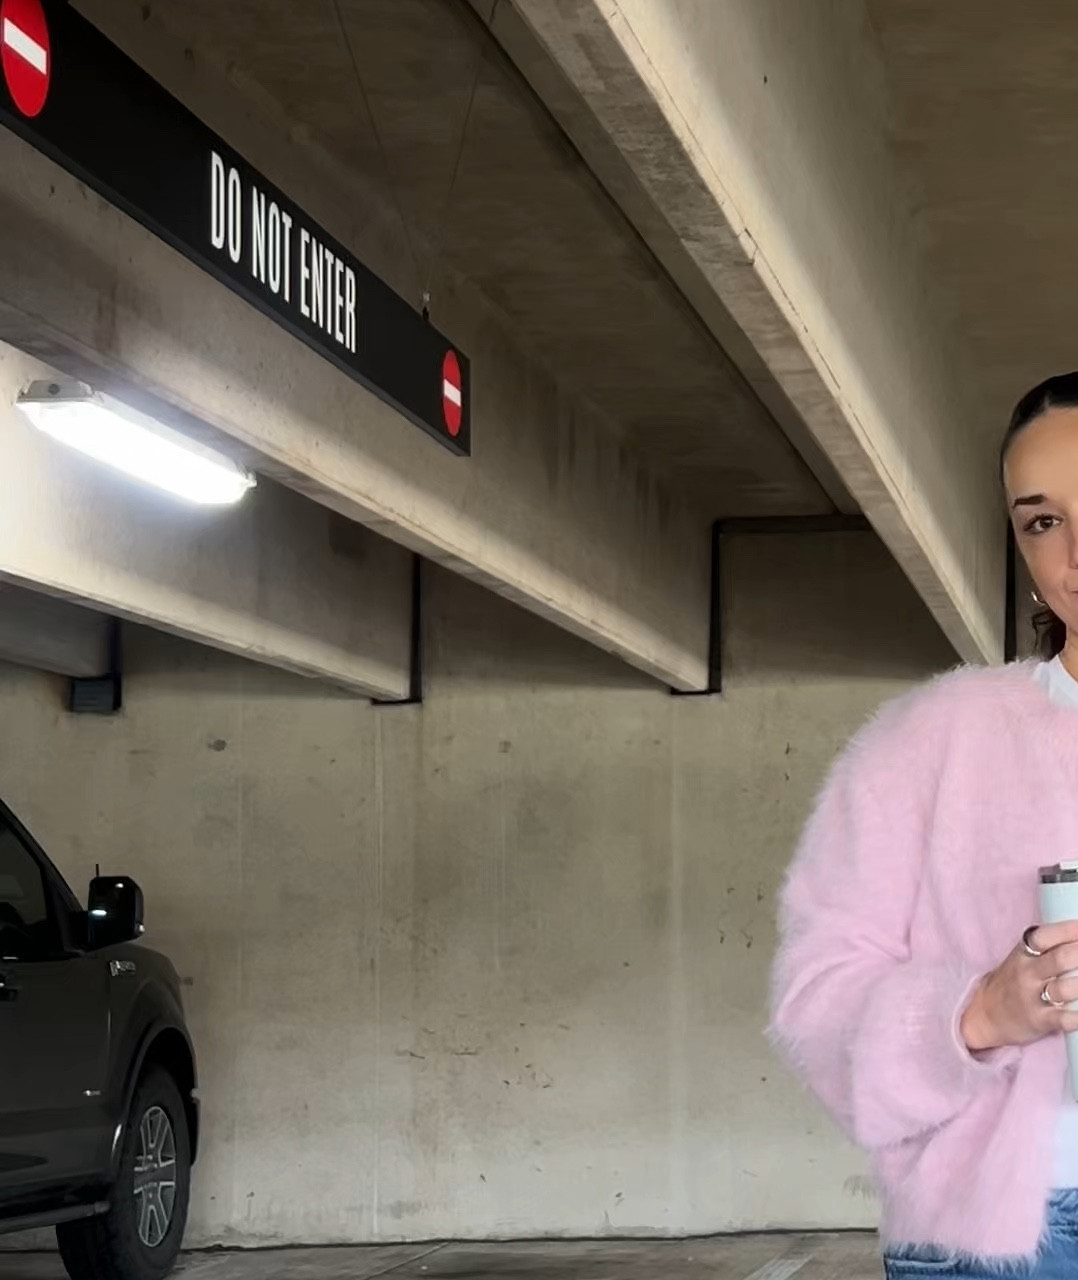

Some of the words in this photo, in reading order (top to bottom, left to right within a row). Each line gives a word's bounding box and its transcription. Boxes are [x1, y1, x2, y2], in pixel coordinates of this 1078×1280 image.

[211, 150, 242, 263] DO
[252, 185, 292, 304] NOT
[300, 227, 356, 354] ENTER
